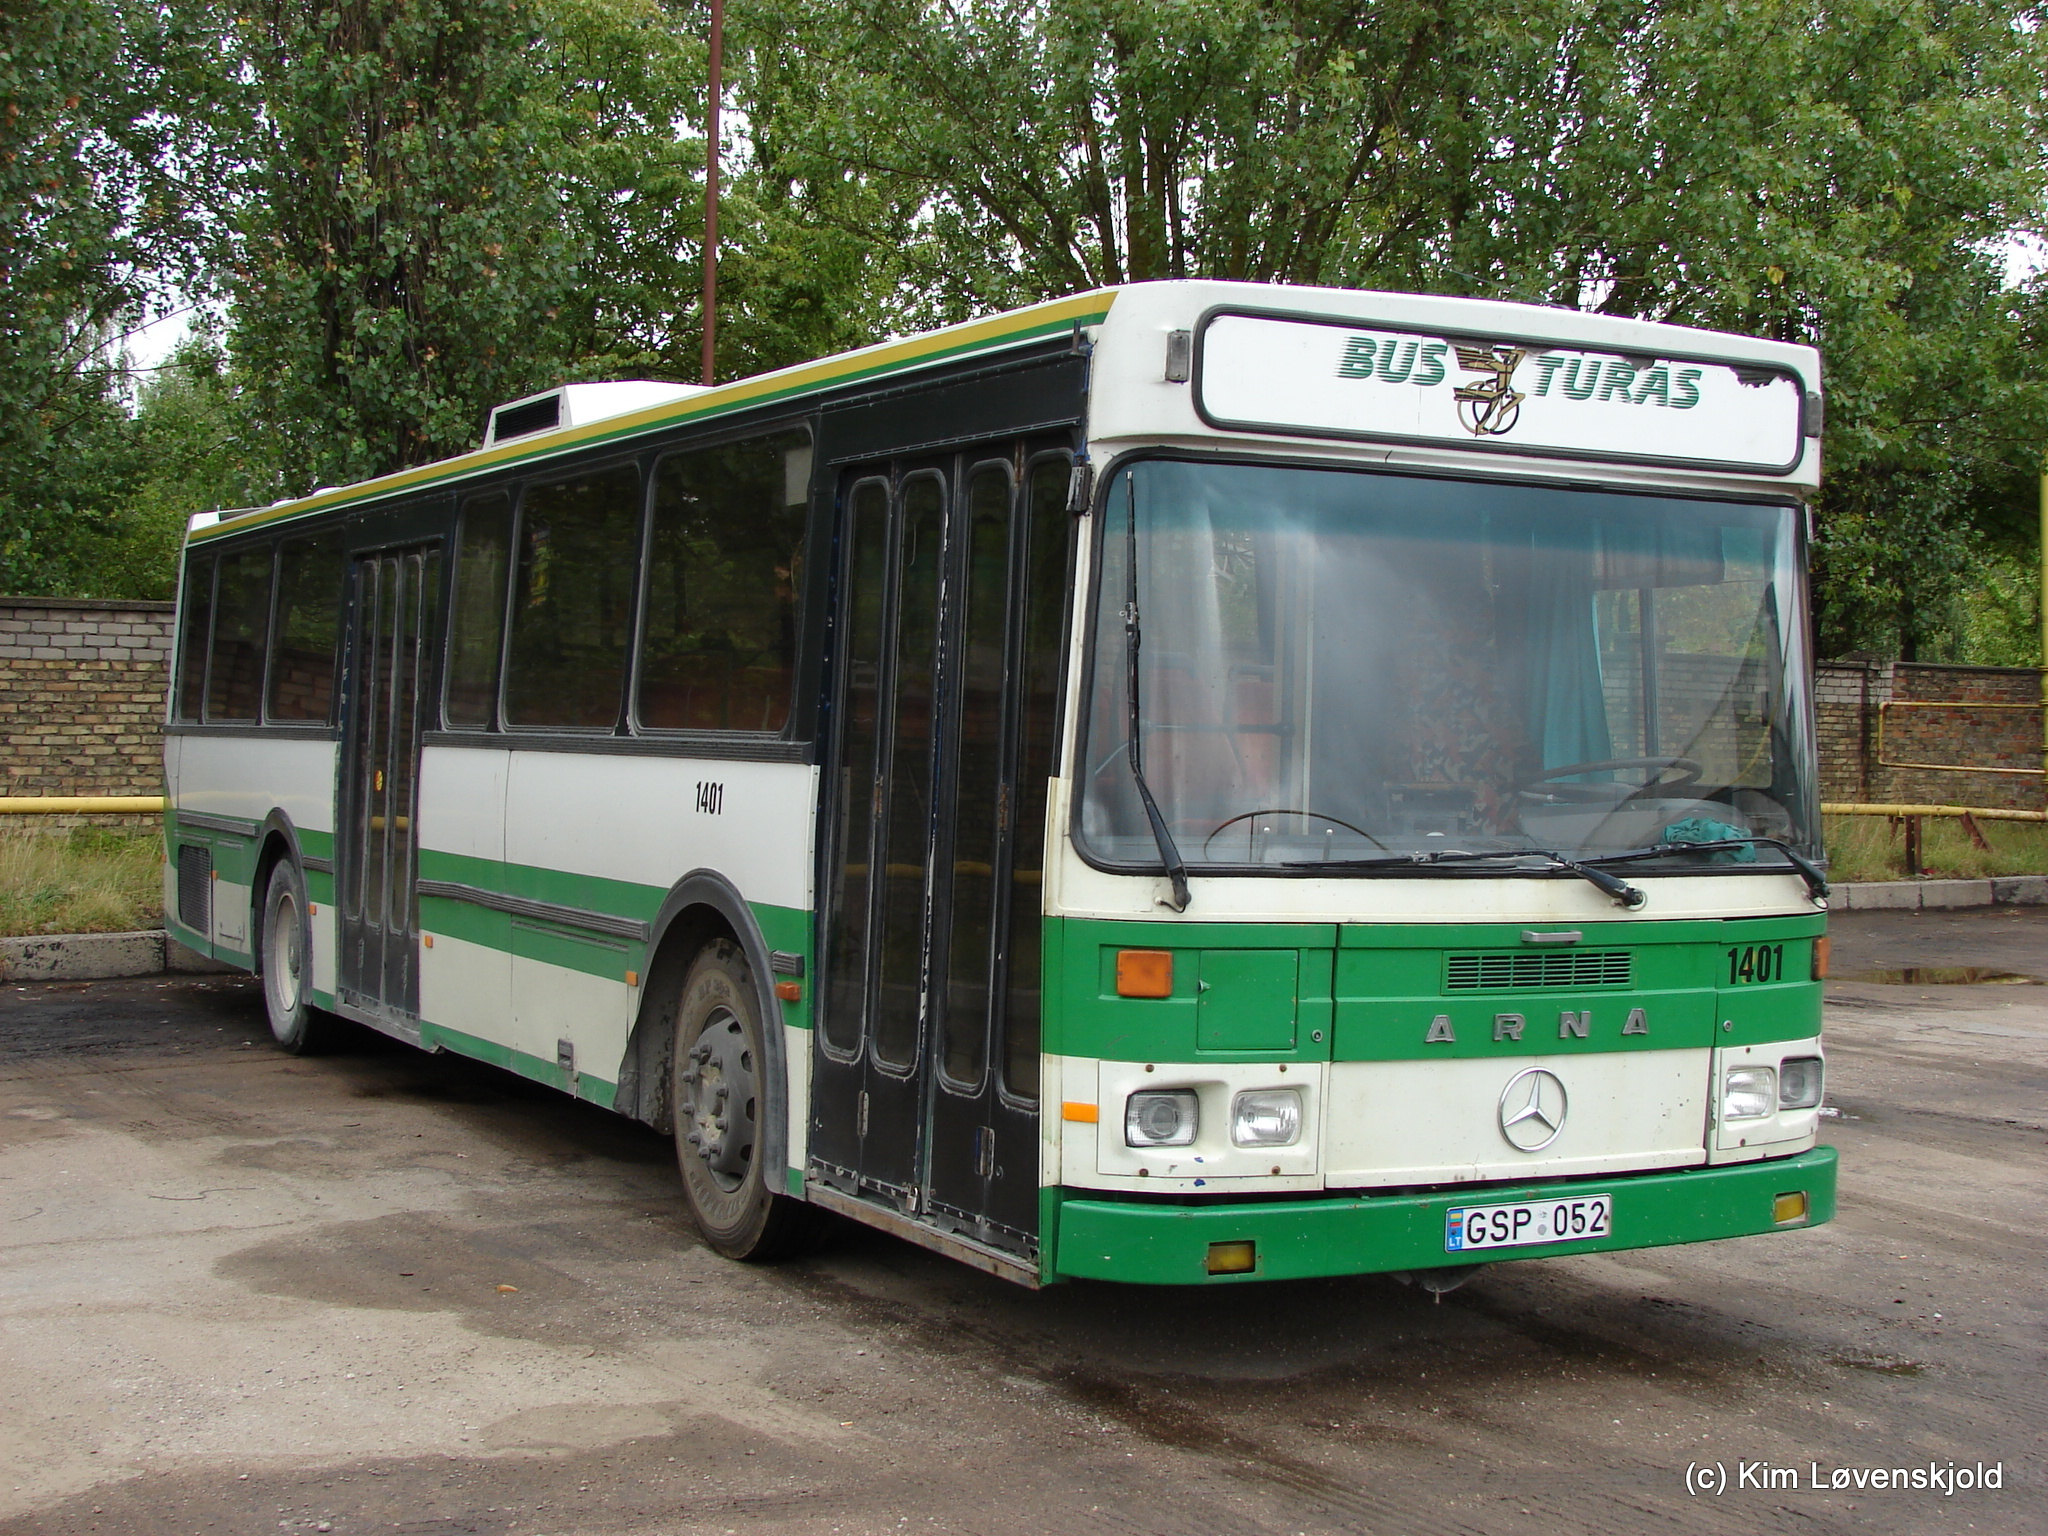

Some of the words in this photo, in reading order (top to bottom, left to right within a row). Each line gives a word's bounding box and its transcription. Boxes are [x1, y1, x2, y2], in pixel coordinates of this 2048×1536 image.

[1334, 336, 1449, 387] BUS
[1532, 353, 1702, 410] TURAS
[696, 781, 723, 815] 1401
[1727, 944, 1783, 985] 1401
[1425, 1007, 1649, 1043] ARNA
[1449, 1236, 1461, 1247] LT
[1466, 1208, 1532, 1244] GSP
[1554, 1201, 1605, 1236] 052
